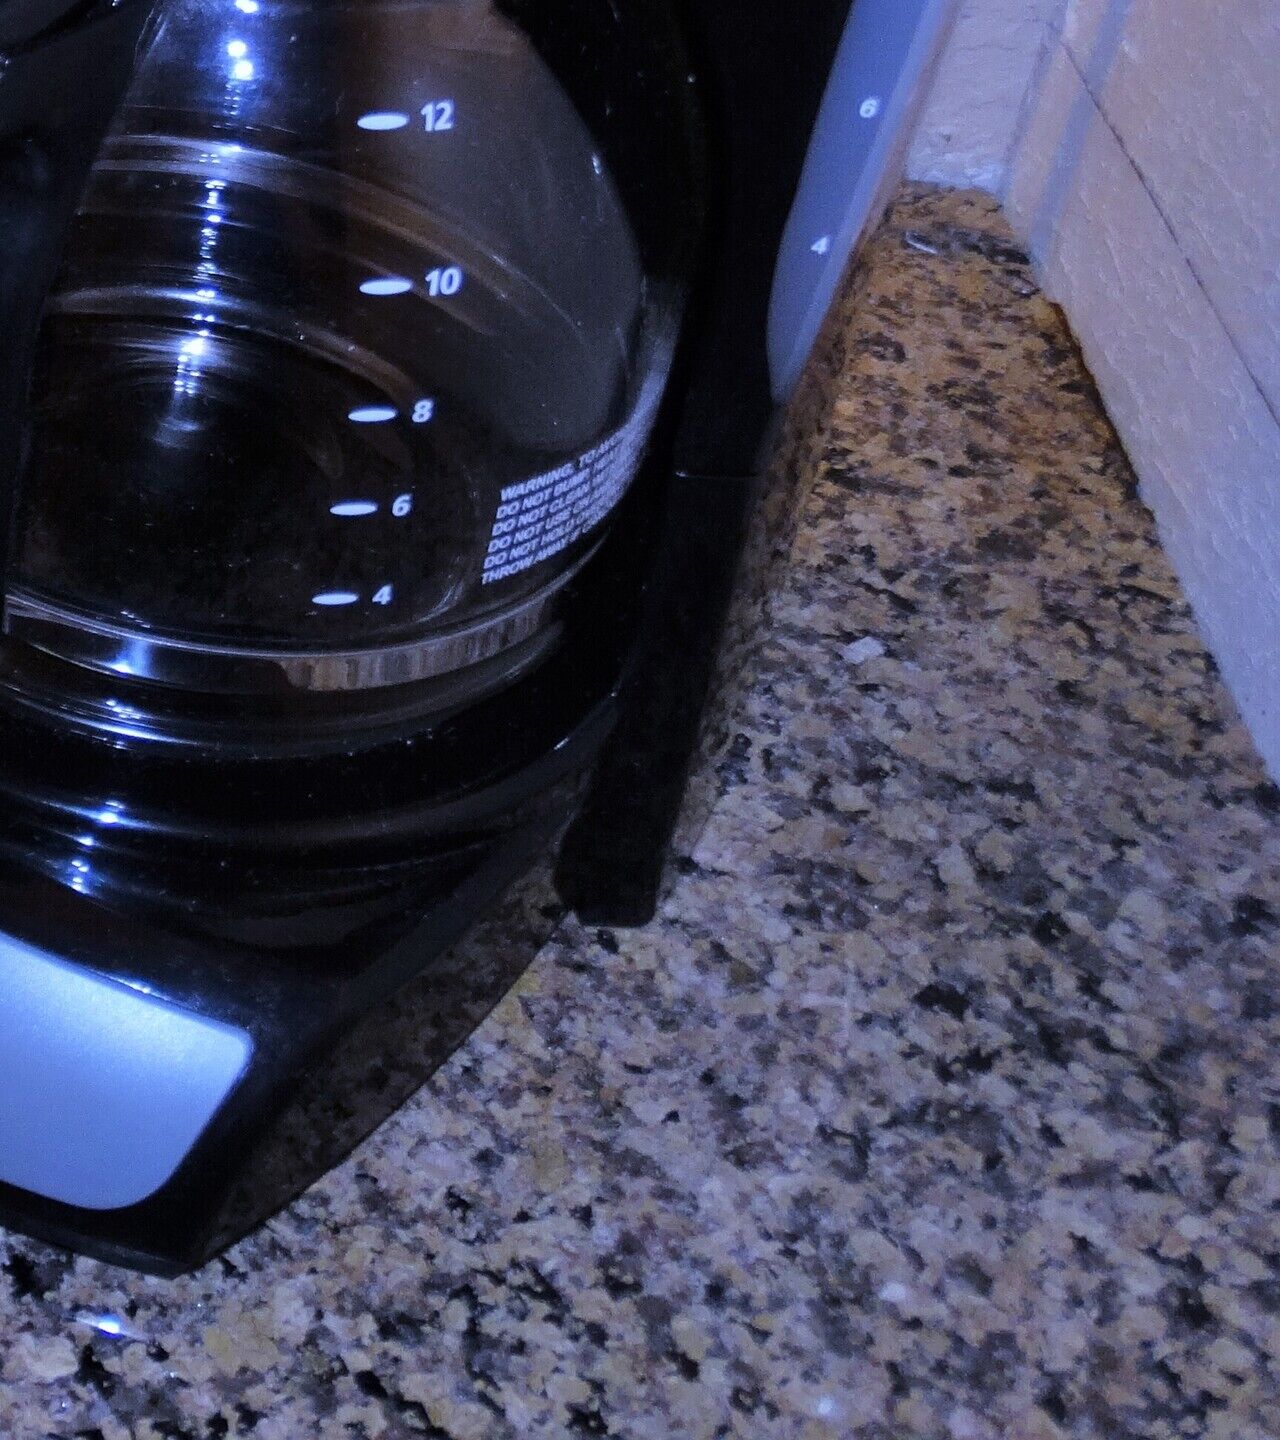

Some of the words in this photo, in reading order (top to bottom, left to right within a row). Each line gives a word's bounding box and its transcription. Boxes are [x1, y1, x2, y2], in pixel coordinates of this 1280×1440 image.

[420, 99, 455, 132] 12
[858, 97, 879, 119] 6
[810, 236, 830, 255] 4
[424, 265, 462, 297] 10
[411, 398, 434, 424] 8
[391, 492, 413, 517] 6
[495, 500, 520, 519] DO
[521, 487, 553, 511] NOT
[491, 518, 517, 537] DO
[517, 504, 549, 528] NOT
[483, 552, 508, 569] DO
[508, 537, 540, 560] NOT
[488, 535, 512, 553] DO
[513, 521, 545, 544] NOT
[371, 583, 394, 605] 4
